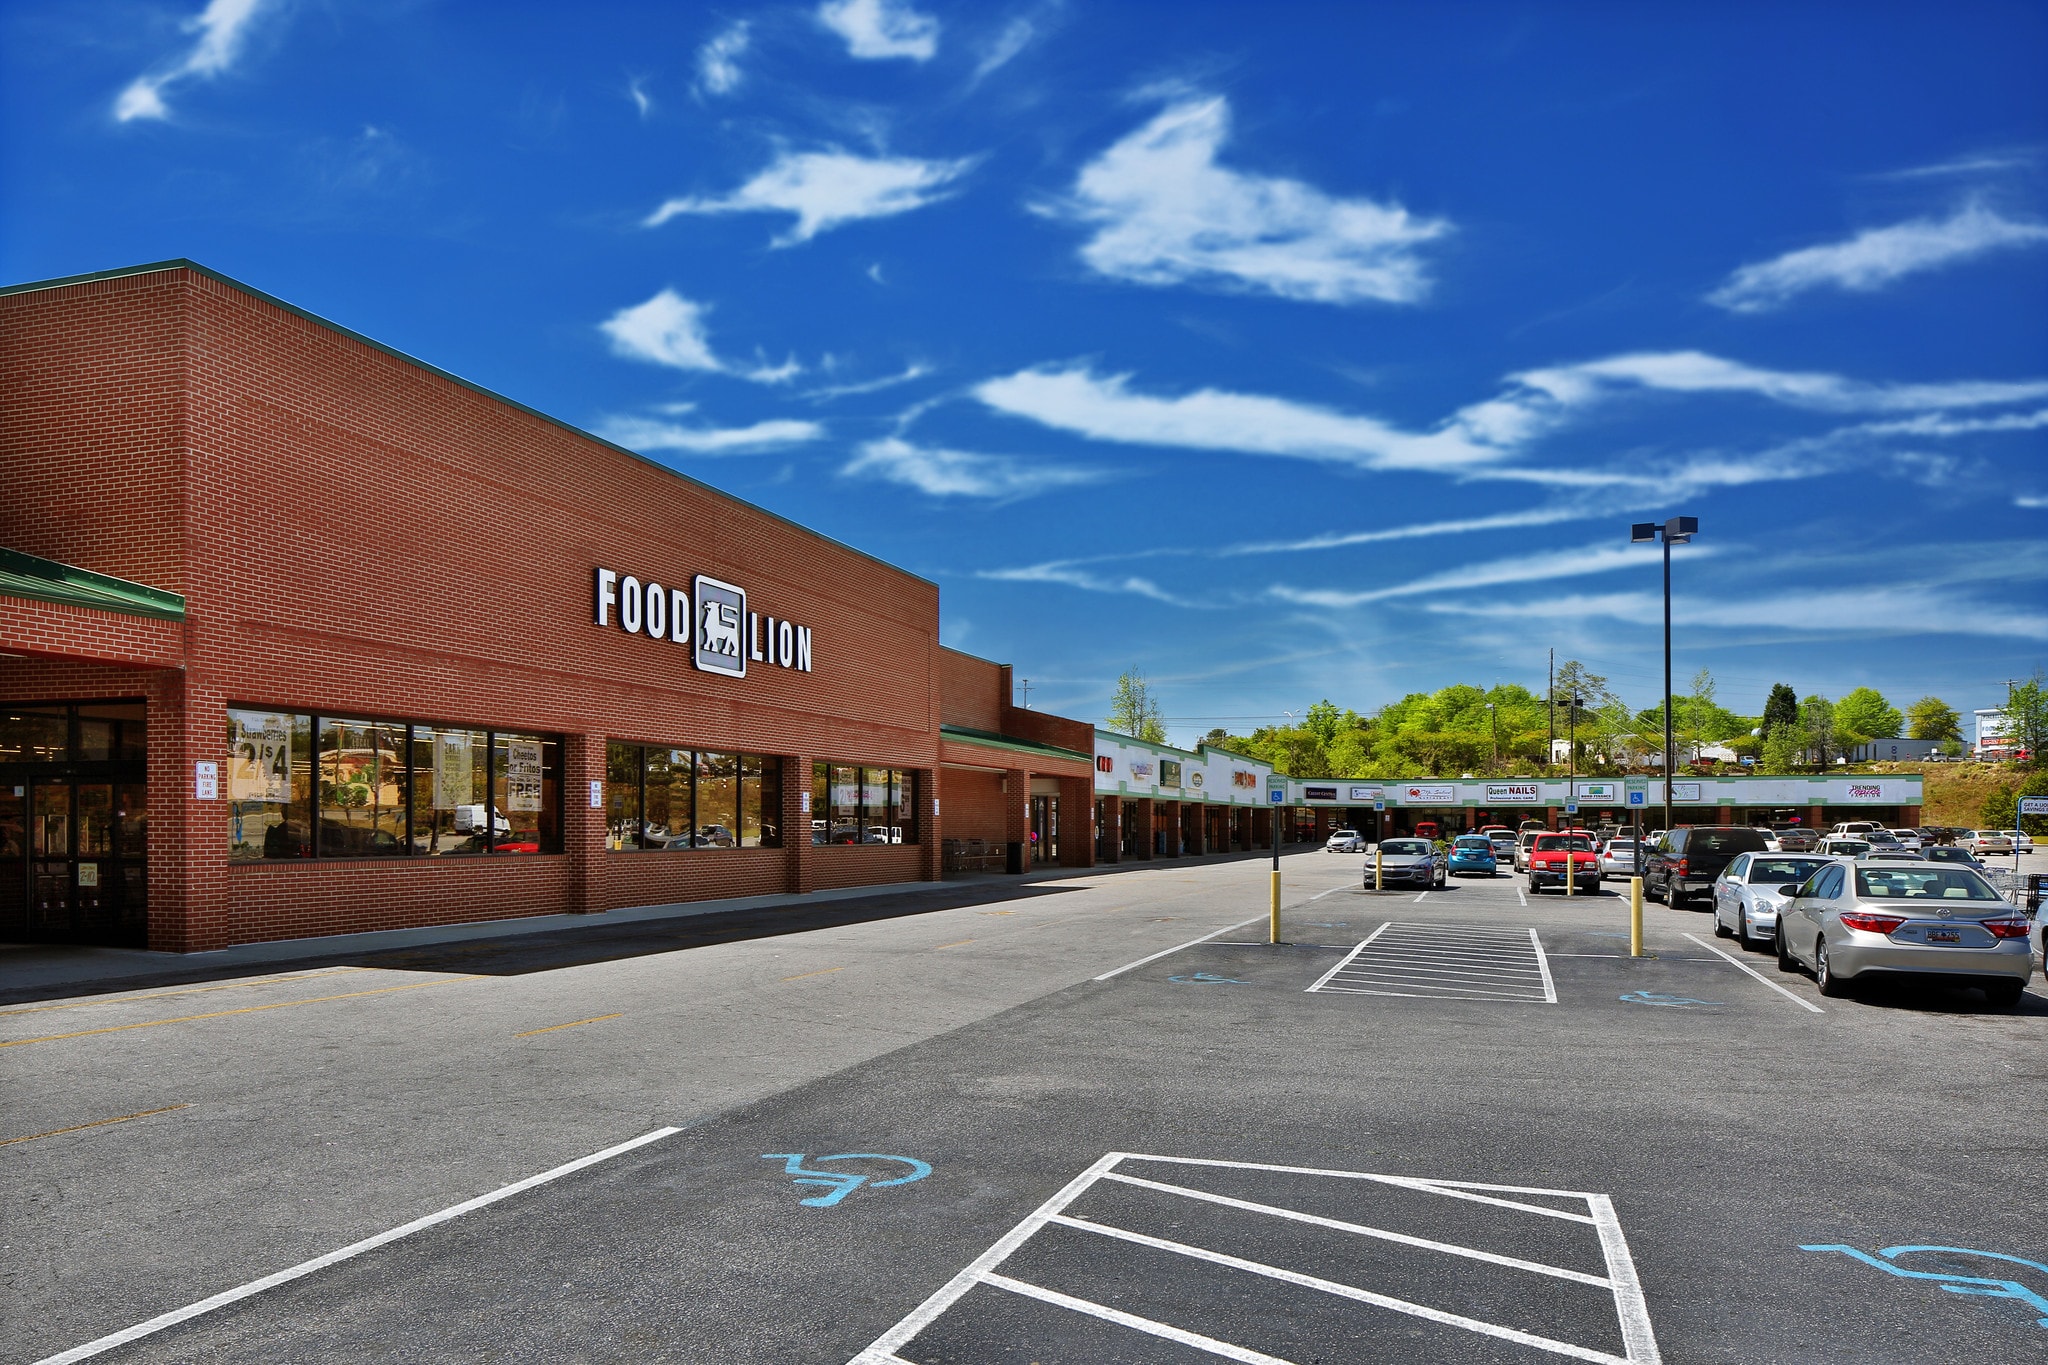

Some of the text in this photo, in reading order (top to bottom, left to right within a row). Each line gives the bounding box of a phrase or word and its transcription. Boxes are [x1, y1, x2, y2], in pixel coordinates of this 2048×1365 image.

[594, 567, 812, 673] FOOD LION
[241, 723, 287, 742] Strawberries
[513, 748, 537, 761] Cheetos
[510, 762, 541, 774] or Fritos
[508, 783, 541, 799] FREE
[1489, 786, 1536, 796] Queen NAILS
